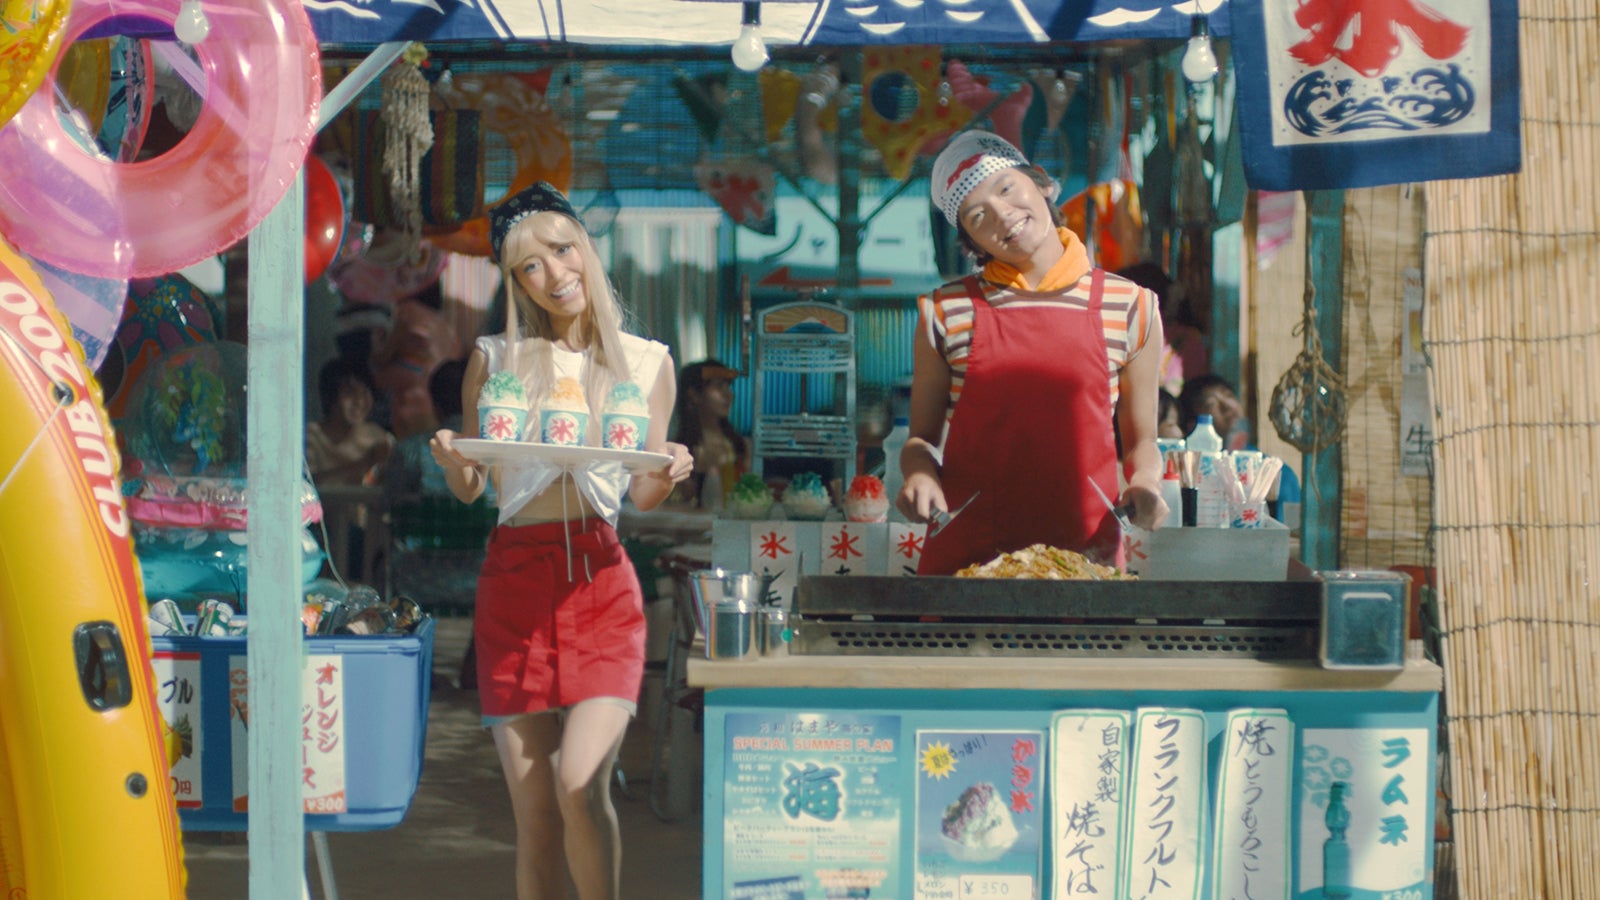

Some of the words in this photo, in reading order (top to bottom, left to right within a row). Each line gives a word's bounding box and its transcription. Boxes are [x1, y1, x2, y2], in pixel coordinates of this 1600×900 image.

[0, 281, 84, 387] 200
[64, 399, 128, 537] CLUB
[758, 531, 793, 560] 氷
[896, 531, 924, 560] 氷
[315, 662, 339, 754] オレンジ
[733, 736, 789, 751] SPECIAL
[794, 738, 852, 752] SUMMER
[856, 739, 893, 753] PLAN
[1096, 722, 1121, 803] 自家製
[1143, 718, 1181, 894] フランクフルト
[1234, 718, 1277, 900] 焼とうもろこし
[1064, 801, 1106, 896] 焼そば
